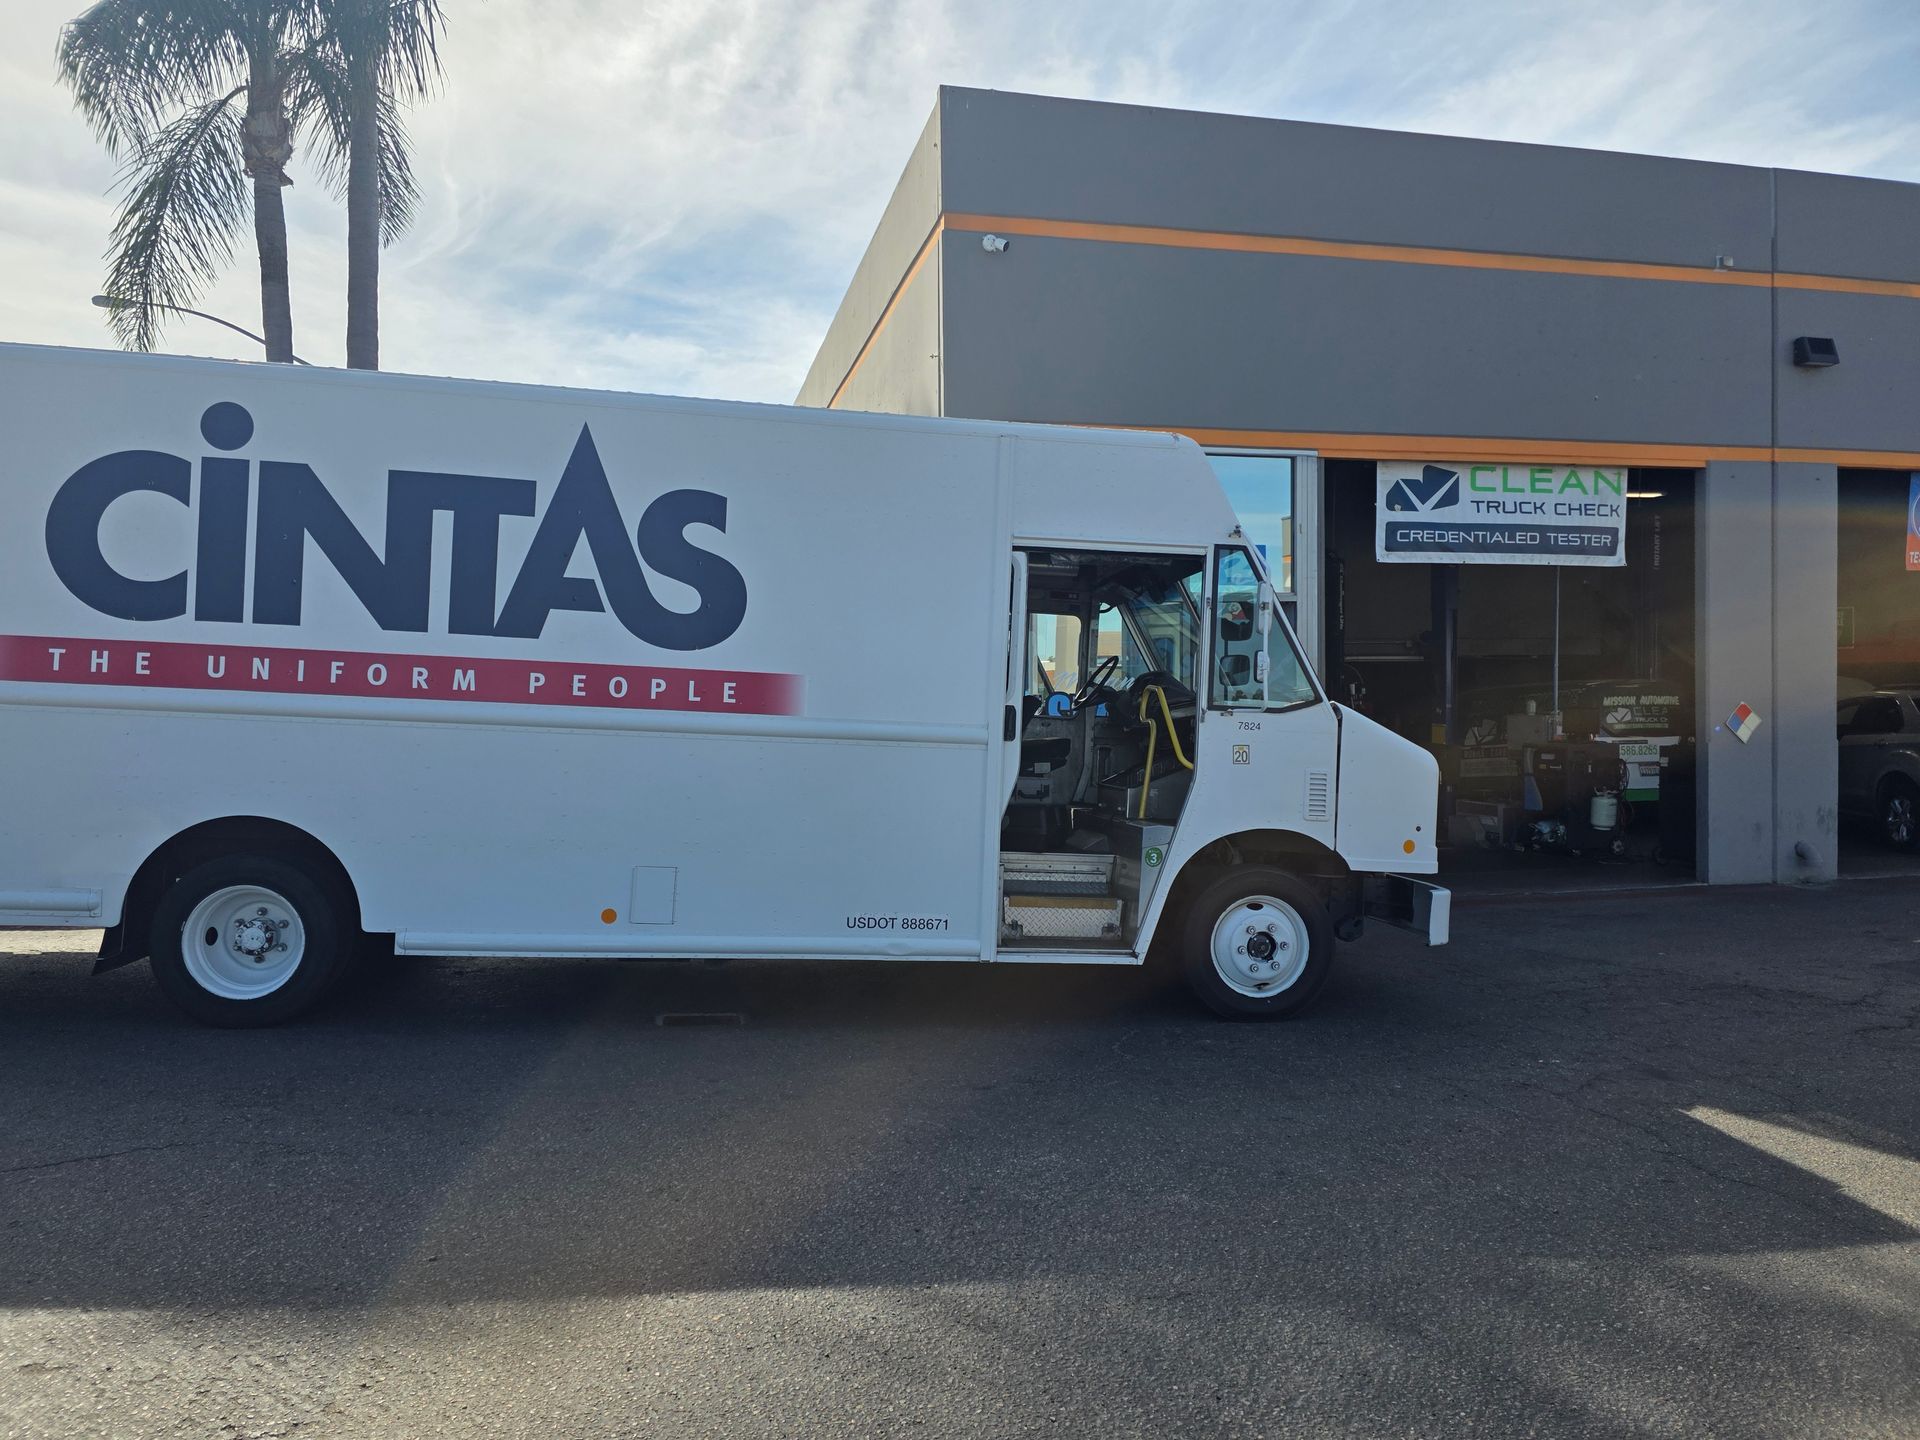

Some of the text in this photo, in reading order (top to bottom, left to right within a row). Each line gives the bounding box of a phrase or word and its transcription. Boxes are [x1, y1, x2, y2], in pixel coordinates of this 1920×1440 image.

[1470, 466, 1621, 496] CLEAN
[1470, 500, 1621, 518] TRUCK CHECK
[1396, 529, 1612, 547] CREDENTIALED TESTER
[1909, 551, 1920, 563] TE
[48, 647, 738, 703] THE UNIFORM PEOPLE
[1238, 721, 1261, 731] 7824
[1235, 750, 1248, 763] 20
[1150, 853, 1157, 863] 3
[846, 917, 950, 931] USDOT 888671
